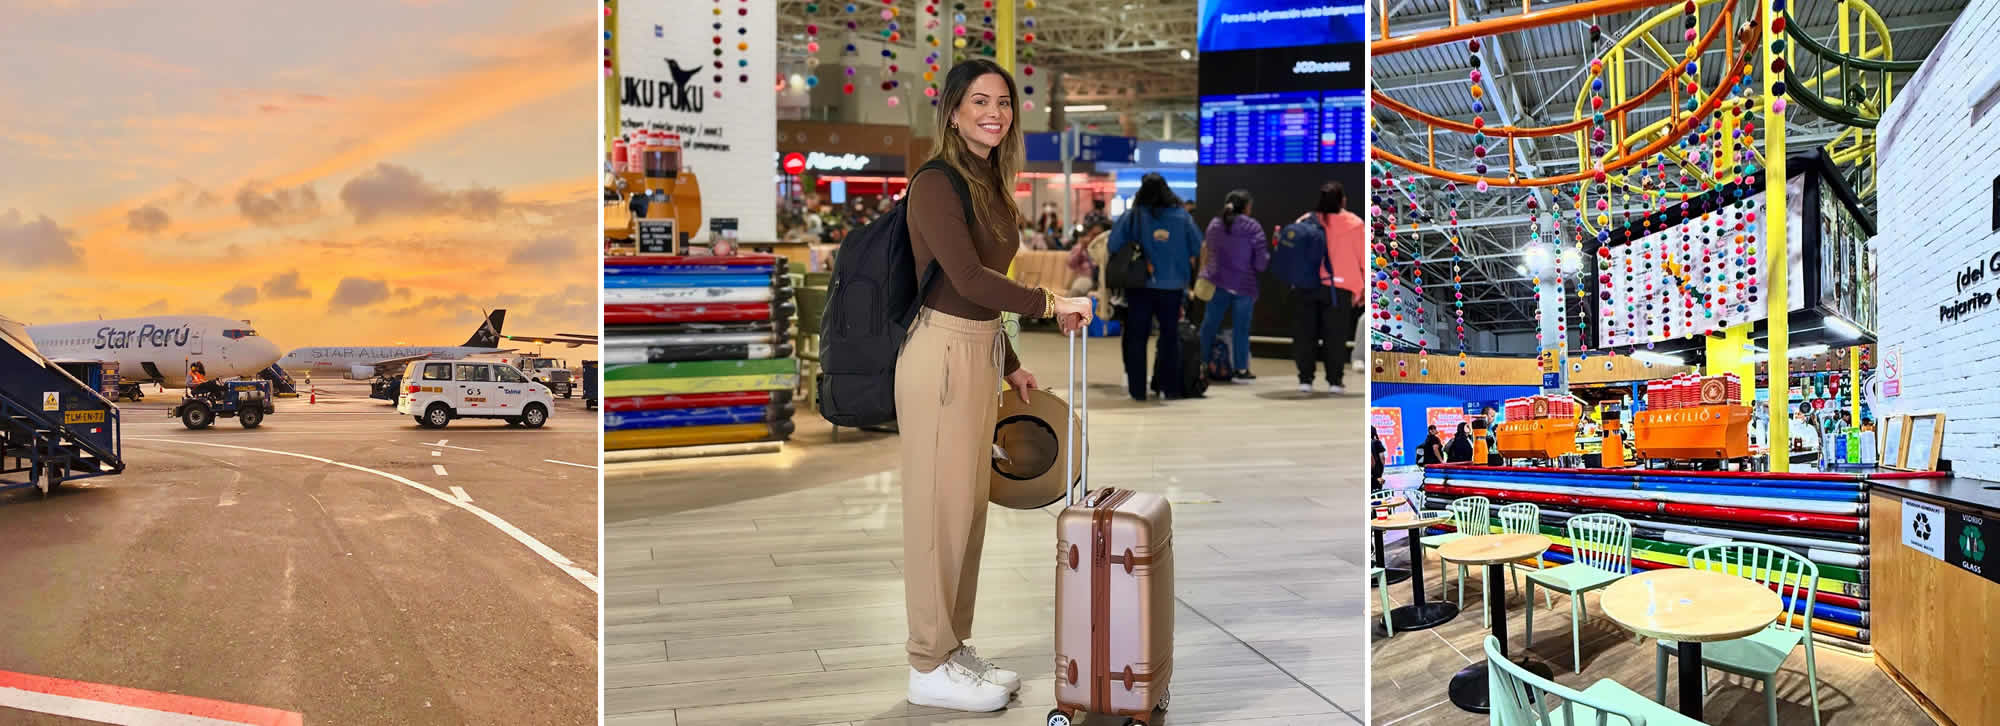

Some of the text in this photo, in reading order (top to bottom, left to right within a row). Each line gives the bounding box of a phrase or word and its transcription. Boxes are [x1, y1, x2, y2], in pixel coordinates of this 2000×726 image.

[658, 80, 703, 113] PUKU
[1956, 260, 1985, 292] (del
[1940, 293, 1992, 321] Pajarito
[94, 323, 190, 350] Star Perú
[311, 347, 354, 359] STAR
[1649, 408, 1711, 425] RANCILIO
[1505, 421, 1539, 432] RANCILIO
[1962, 513, 1983, 525] VIDRIO
[1962, 560, 1981, 574] GLASS
